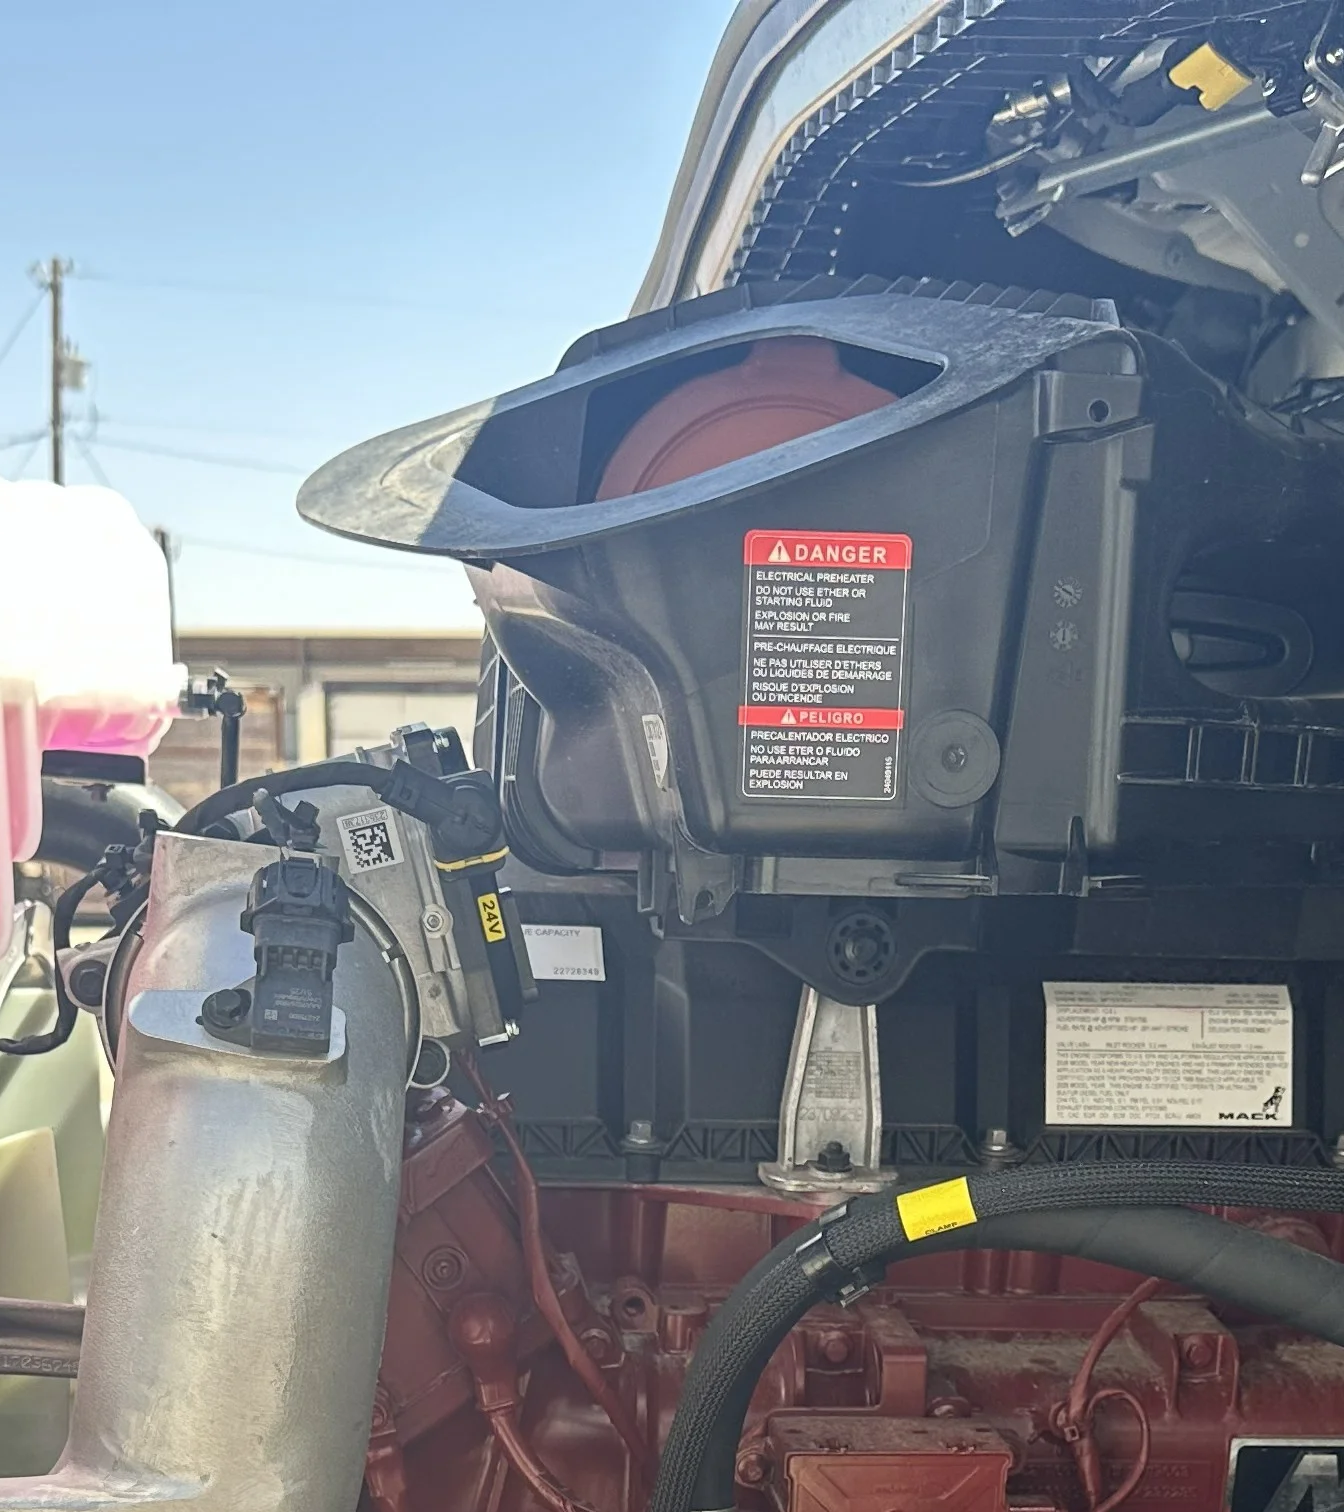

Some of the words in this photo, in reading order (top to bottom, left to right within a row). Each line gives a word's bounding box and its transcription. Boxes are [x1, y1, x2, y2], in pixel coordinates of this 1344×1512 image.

[795, 544, 886, 563] DANGER
[756, 571, 814, 581] ELECTRICAL
[817, 573, 874, 583] PREHEATER
[756, 586, 770, 596] DO
[772, 586, 793, 595] NOT
[795, 587, 814, 596] USE
[817, 587, 848, 597] ETHER
[851, 588, 866, 598] OR
[755, 596, 802, 606] STARTING
[805, 597, 832, 607] FLUID
[755, 611, 809, 622] EXPLOSION
[812, 612, 826, 621] OR
[828, 612, 850, 622] FIRE
[754, 621, 774, 630] MAY
[776, 622, 813, 631] RESULT
[754, 642, 833, 653] PRE-CHAUFFAGE
[836, 644, 896, 654] ELECTRIQUE
[754, 658, 766, 669] NE
[769, 659, 787, 669] PAS
[790, 659, 832, 670] UTILISER
[834, 660, 881, 670] D'ETHERS
[753, 668, 767, 677] OU
[770, 668, 813, 678] LIQUIDES
[816, 669, 828, 678] DE
[831, 670, 891, 680] DEMARRAGE
[752, 683, 788, 693] RISQUE
[791, 683, 854, 694] D'EXPLOSION
[752, 693, 766, 701] OU
[768, 693, 822, 702] D'INCENDIE
[800, 712, 862, 725] PELIGRO
[751, 730, 832, 741] PRECALENTADOR
[835, 732, 888, 743] ELECTRICO
[750, 745, 765, 756] NO
[767, 745, 786, 756] USE
[788, 746, 813, 756] ETER
[815, 746, 823, 755] O
[825, 746, 860, 756] FLUIDO
[750, 755, 775, 764] PARA
[776, 755, 828, 765] ARRANCAR
[749, 769, 781, 780] PUEDE
[784, 770, 832, 780] RESULTAR
[834, 771, 847, 780] EN
[749, 780, 802, 788] EXPLOSION
[480, 899, 503, 936] 24V
[535, 928, 580, 937] CAPACITY
[1218, 1112, 1278, 1121] MACK
